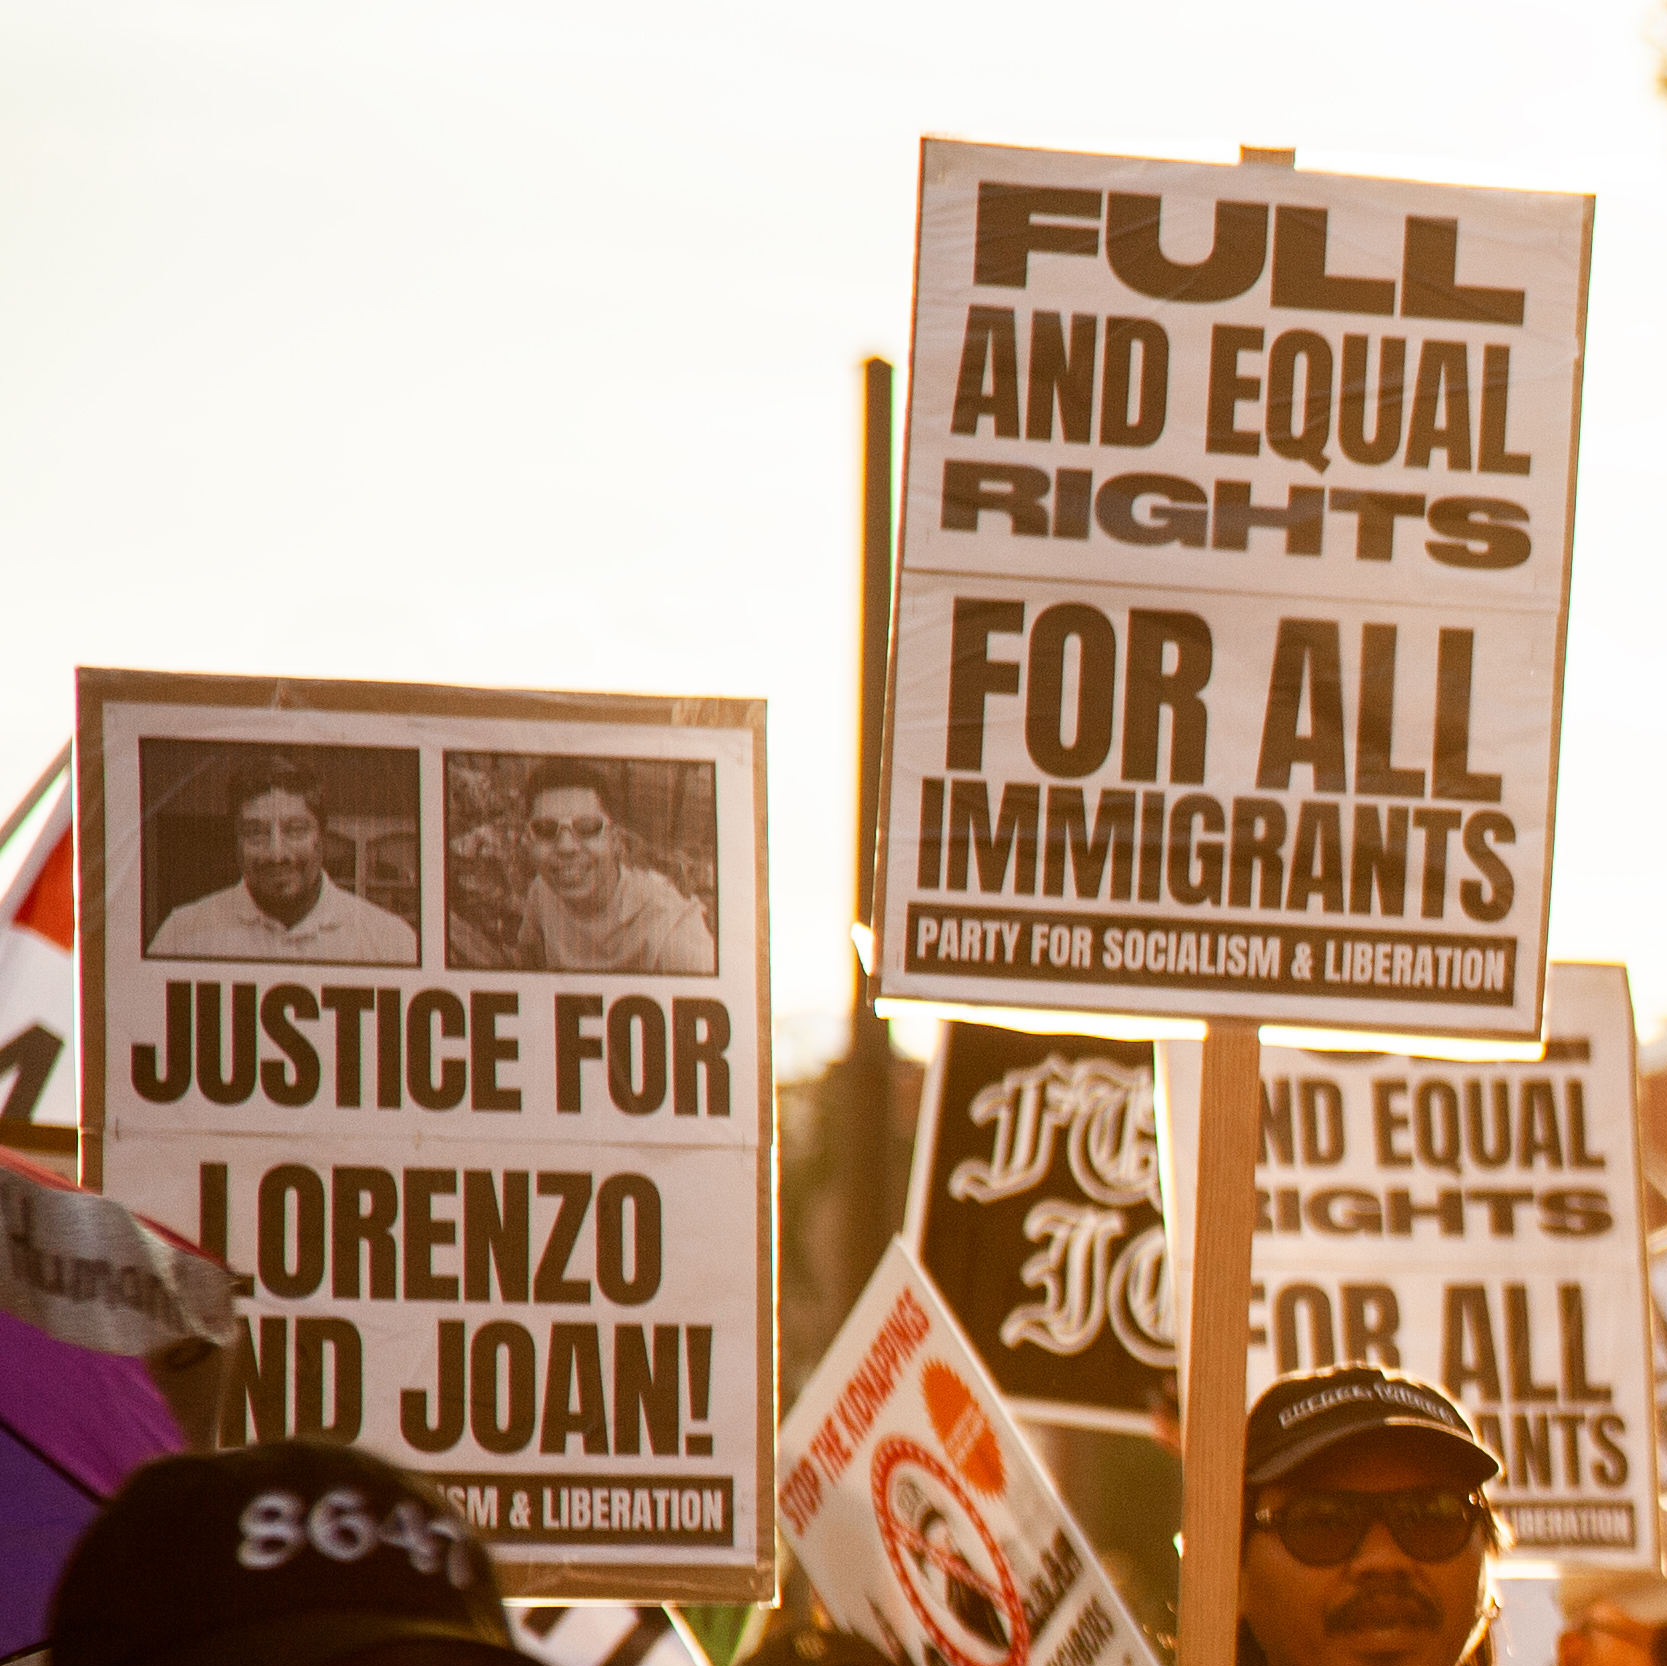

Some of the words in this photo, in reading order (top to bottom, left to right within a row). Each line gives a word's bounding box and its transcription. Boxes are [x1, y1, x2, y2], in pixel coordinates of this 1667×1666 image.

[974, 181, 1526, 326] FULL
[950, 304, 1170, 448] AND
[1205, 324, 1532, 476] EQUAL
[940, 459, 1533, 571] RIGHTS
[945, 597, 1213, 786] FOR
[1254, 618, 1502, 802] ALL
[916, 777, 1517, 924] IMMIGRANTS
[917, 919, 1019, 964] PARTY
[1030, 924, 1091, 970] FOR
[1102, 928, 1280, 980] SOCIALISM
[1292, 943, 1312, 982] &
[1324, 942, 1506, 990] LIBERATION
[131, 980, 521, 1113] JUSTICE
[555, 995, 731, 1117] FOR
[1259, 1076, 1345, 1168] ND
[1372, 1078, 1605, 1175] EQUAL
[200, 1161, 662, 1305] LORENZO
[219, 1316, 362, 1449] ND
[401, 1316, 714, 1458] JOAN!
[1442, 1282, 1611, 1402] ALL
[509, 1490, 531, 1529] &
[543, 1486, 723, 1530] LIBERATION
[778, 1456, 823, 1539] STOP
[809, 1414, 853, 1487] THE
